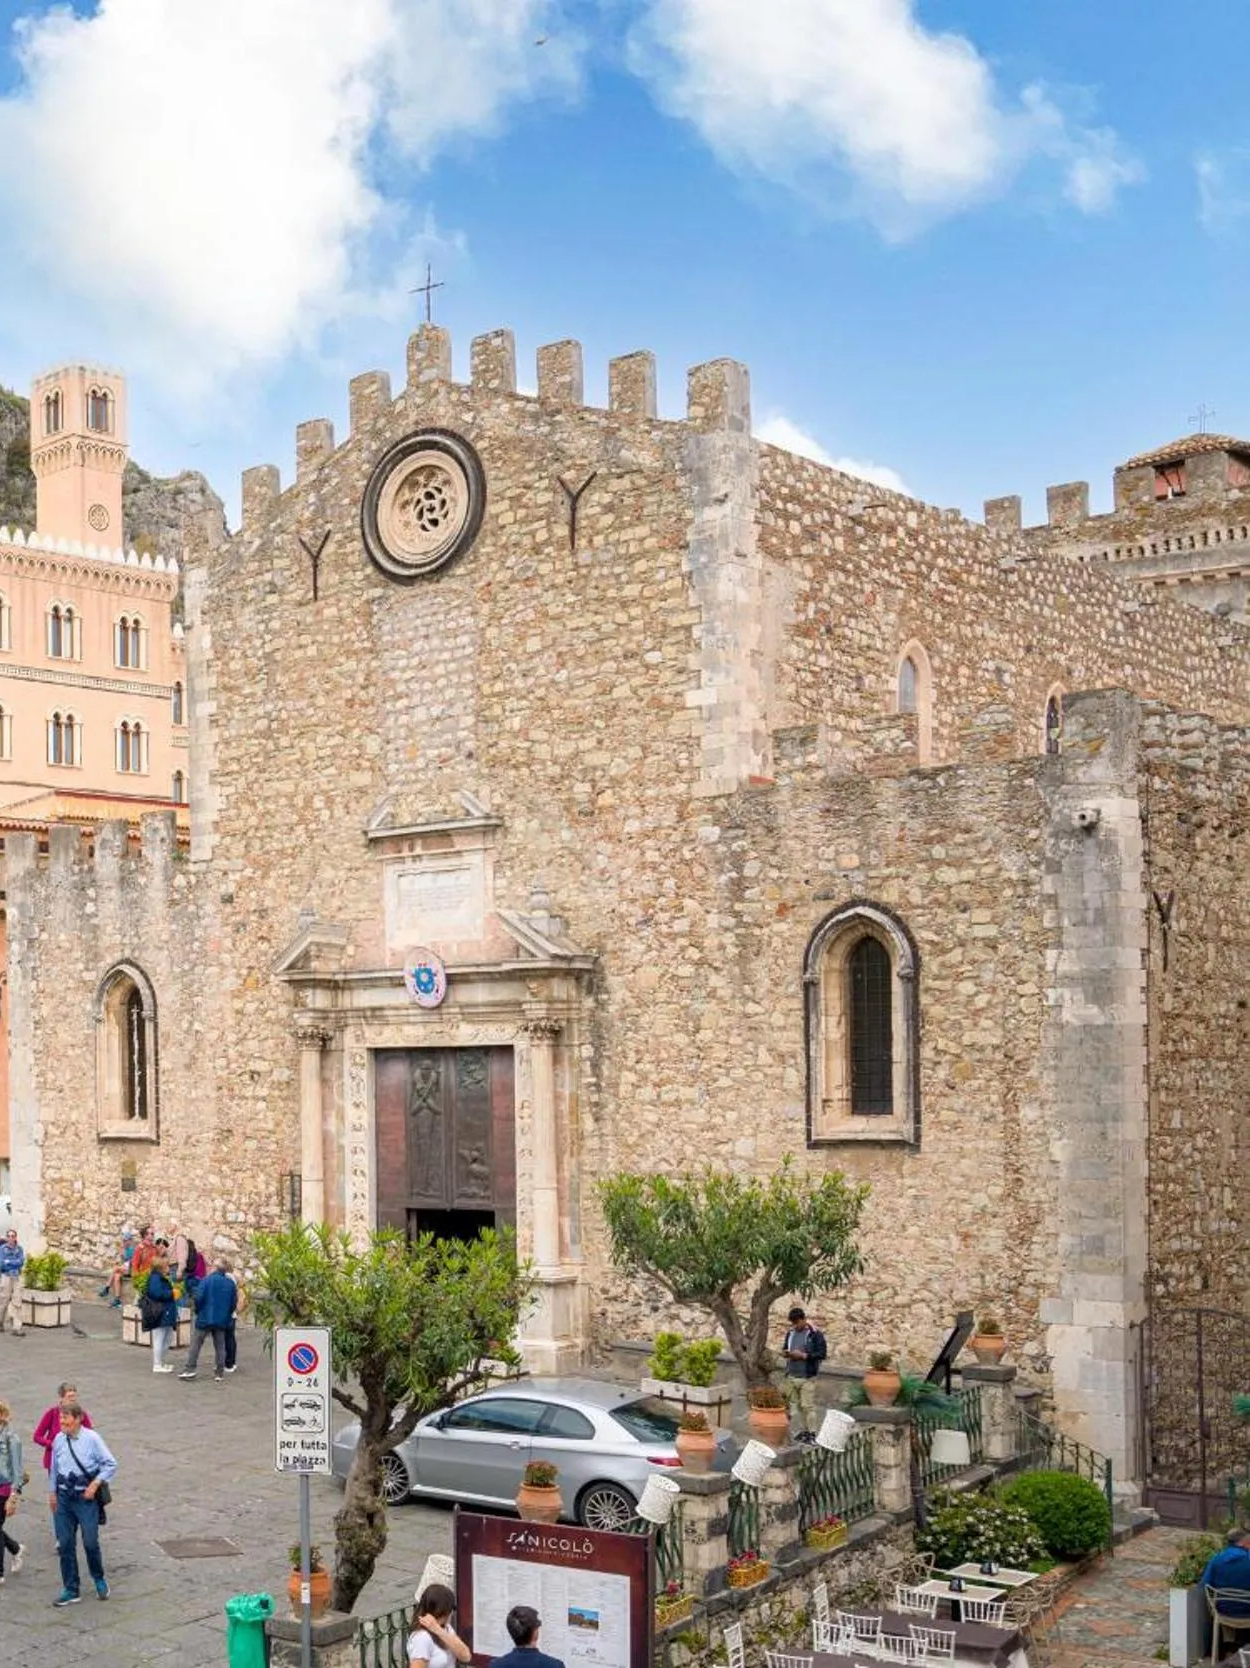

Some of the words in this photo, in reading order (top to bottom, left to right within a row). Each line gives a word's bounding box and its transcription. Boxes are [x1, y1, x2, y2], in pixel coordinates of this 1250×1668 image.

[280, 1440, 297, 1450] per
[301, 1439, 328, 1451] tutta
[280, 1452, 289, 1464] la
[292, 1453, 326, 1467] piazza
